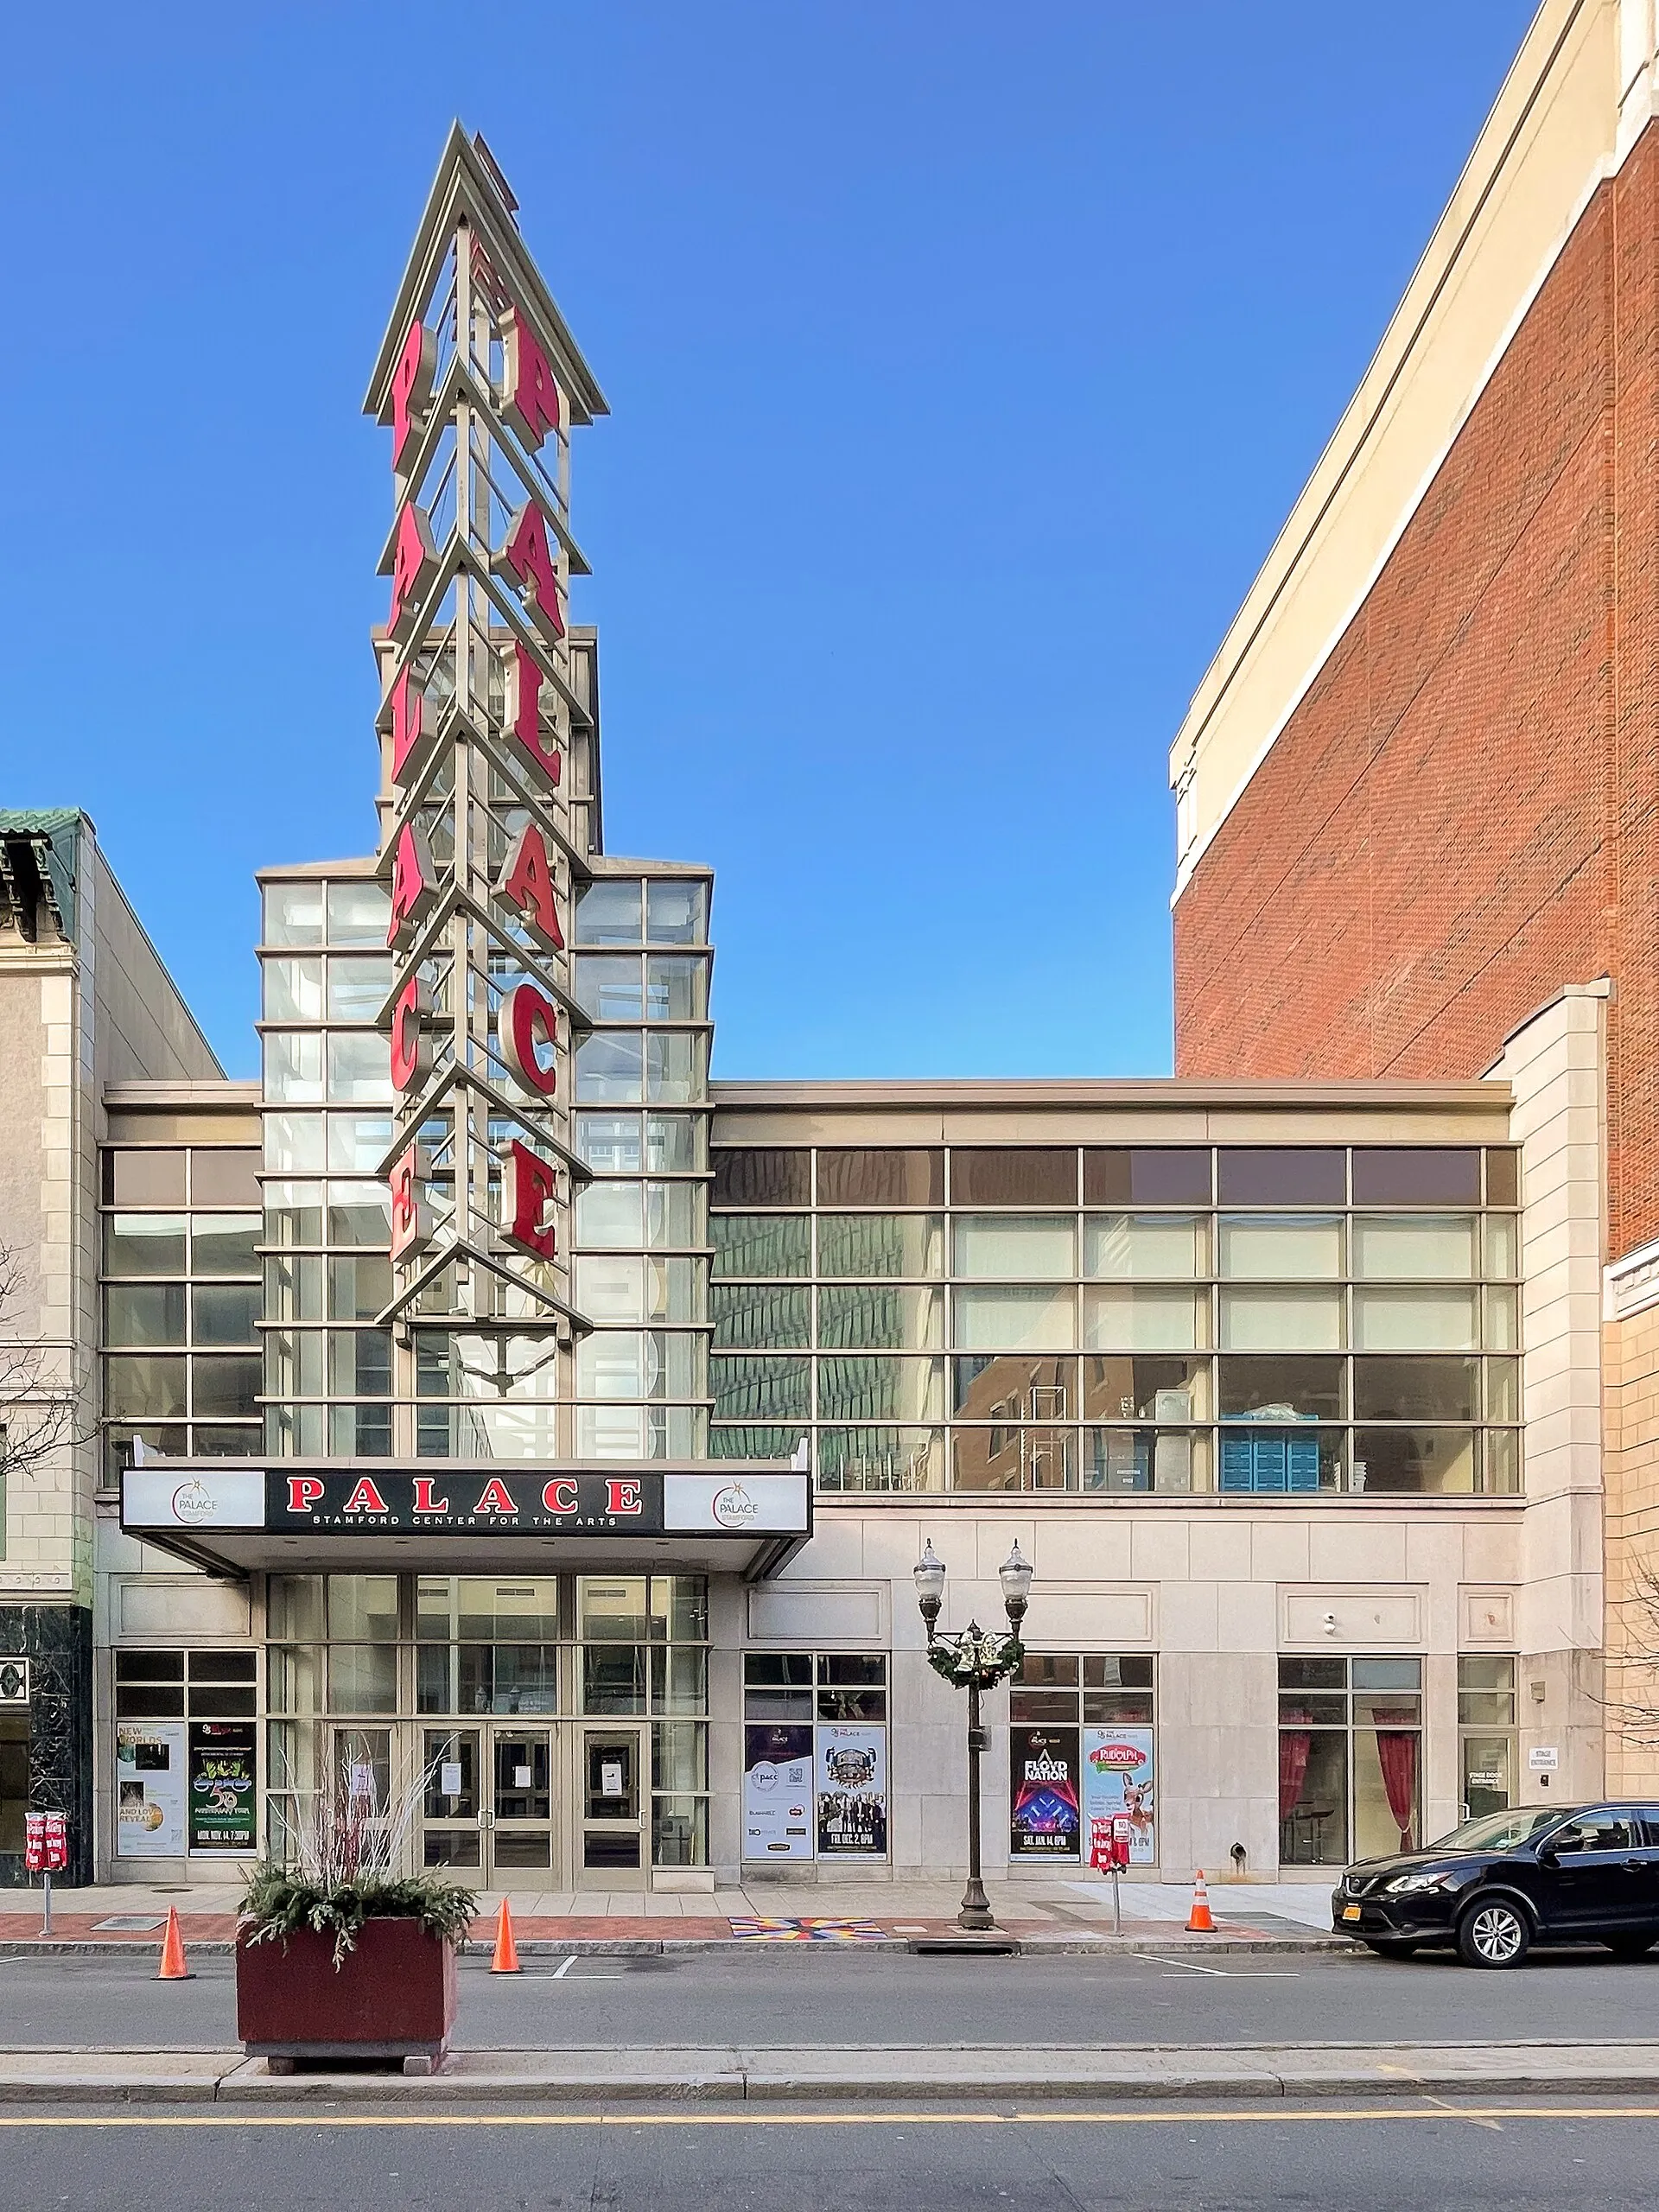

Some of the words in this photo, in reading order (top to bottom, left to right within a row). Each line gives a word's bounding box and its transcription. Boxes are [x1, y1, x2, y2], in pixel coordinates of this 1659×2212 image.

[286, 1476, 642, 1515] PALACE
[179, 1500, 218, 1510] PALACE
[720, 1504, 759, 1514] PALACE
[313, 1516, 401, 1526] STAMFORD
[412, 1516, 476, 1526] CENTER
[489, 1516, 519, 1526] FOR
[533, 1516, 563, 1526] THE
[575, 1516, 617, 1527] ARTS
[1100, 1749, 1138, 1761] RUDOLPH
[1025, 1760, 1068, 1771] FLOYD
[1025, 1770, 1068, 1781] NATION
